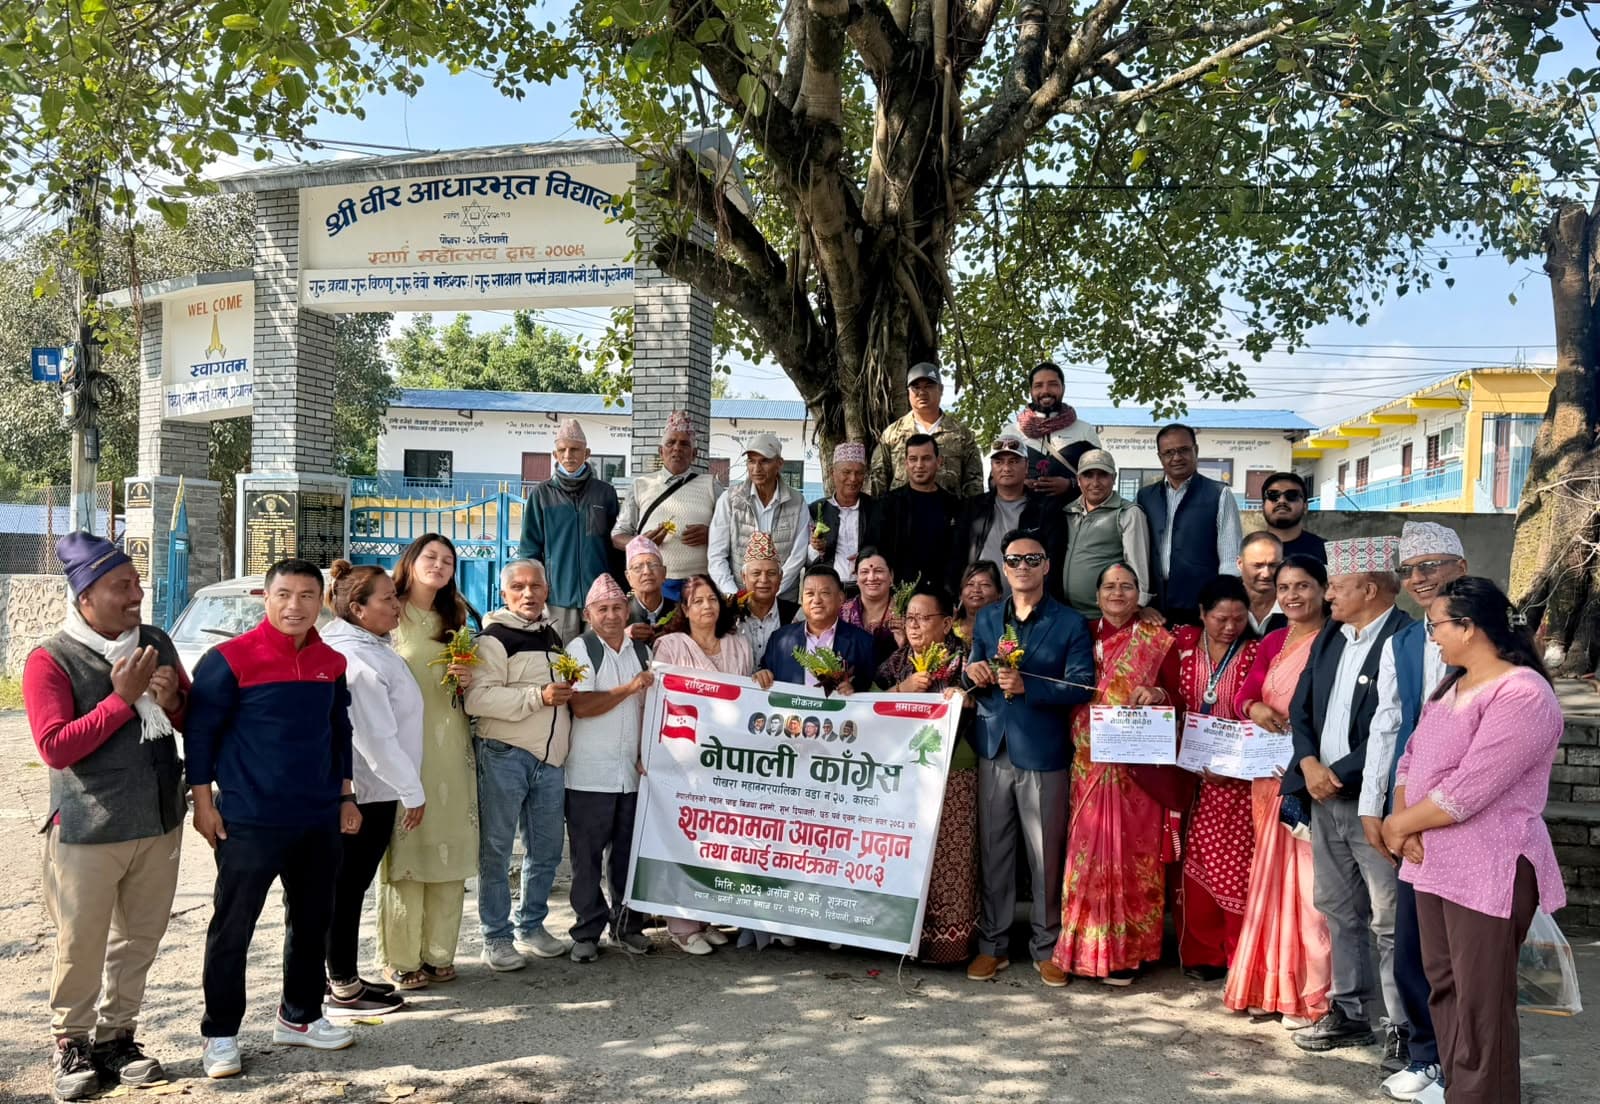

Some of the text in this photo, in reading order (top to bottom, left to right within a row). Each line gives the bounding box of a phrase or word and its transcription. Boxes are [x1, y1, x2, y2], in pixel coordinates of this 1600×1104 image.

[325, 198, 358, 237] श्री
[360, 185, 402, 215] वीर
[407, 176, 540, 204] आधारभूत
[187, 294, 243, 317] WEL COME
[700, 735, 904, 793] नेपाली काँग्रेस
[712, 775, 737, 789] पोखरा
[741, 779, 801, 797] महानगरपालिका
[804, 787, 820, 799] वडा
[852, 794, 880, 808] कास्की
[678, 804, 913, 863] शुभकामना आदान-प्रदान
[699, 841, 886, 888] तथा बधाई कार्यक्रम-२०८३
[739, 883, 762, 897] २०८३
[766, 886, 791, 900] असोज
[793, 890, 805, 903] ३०
